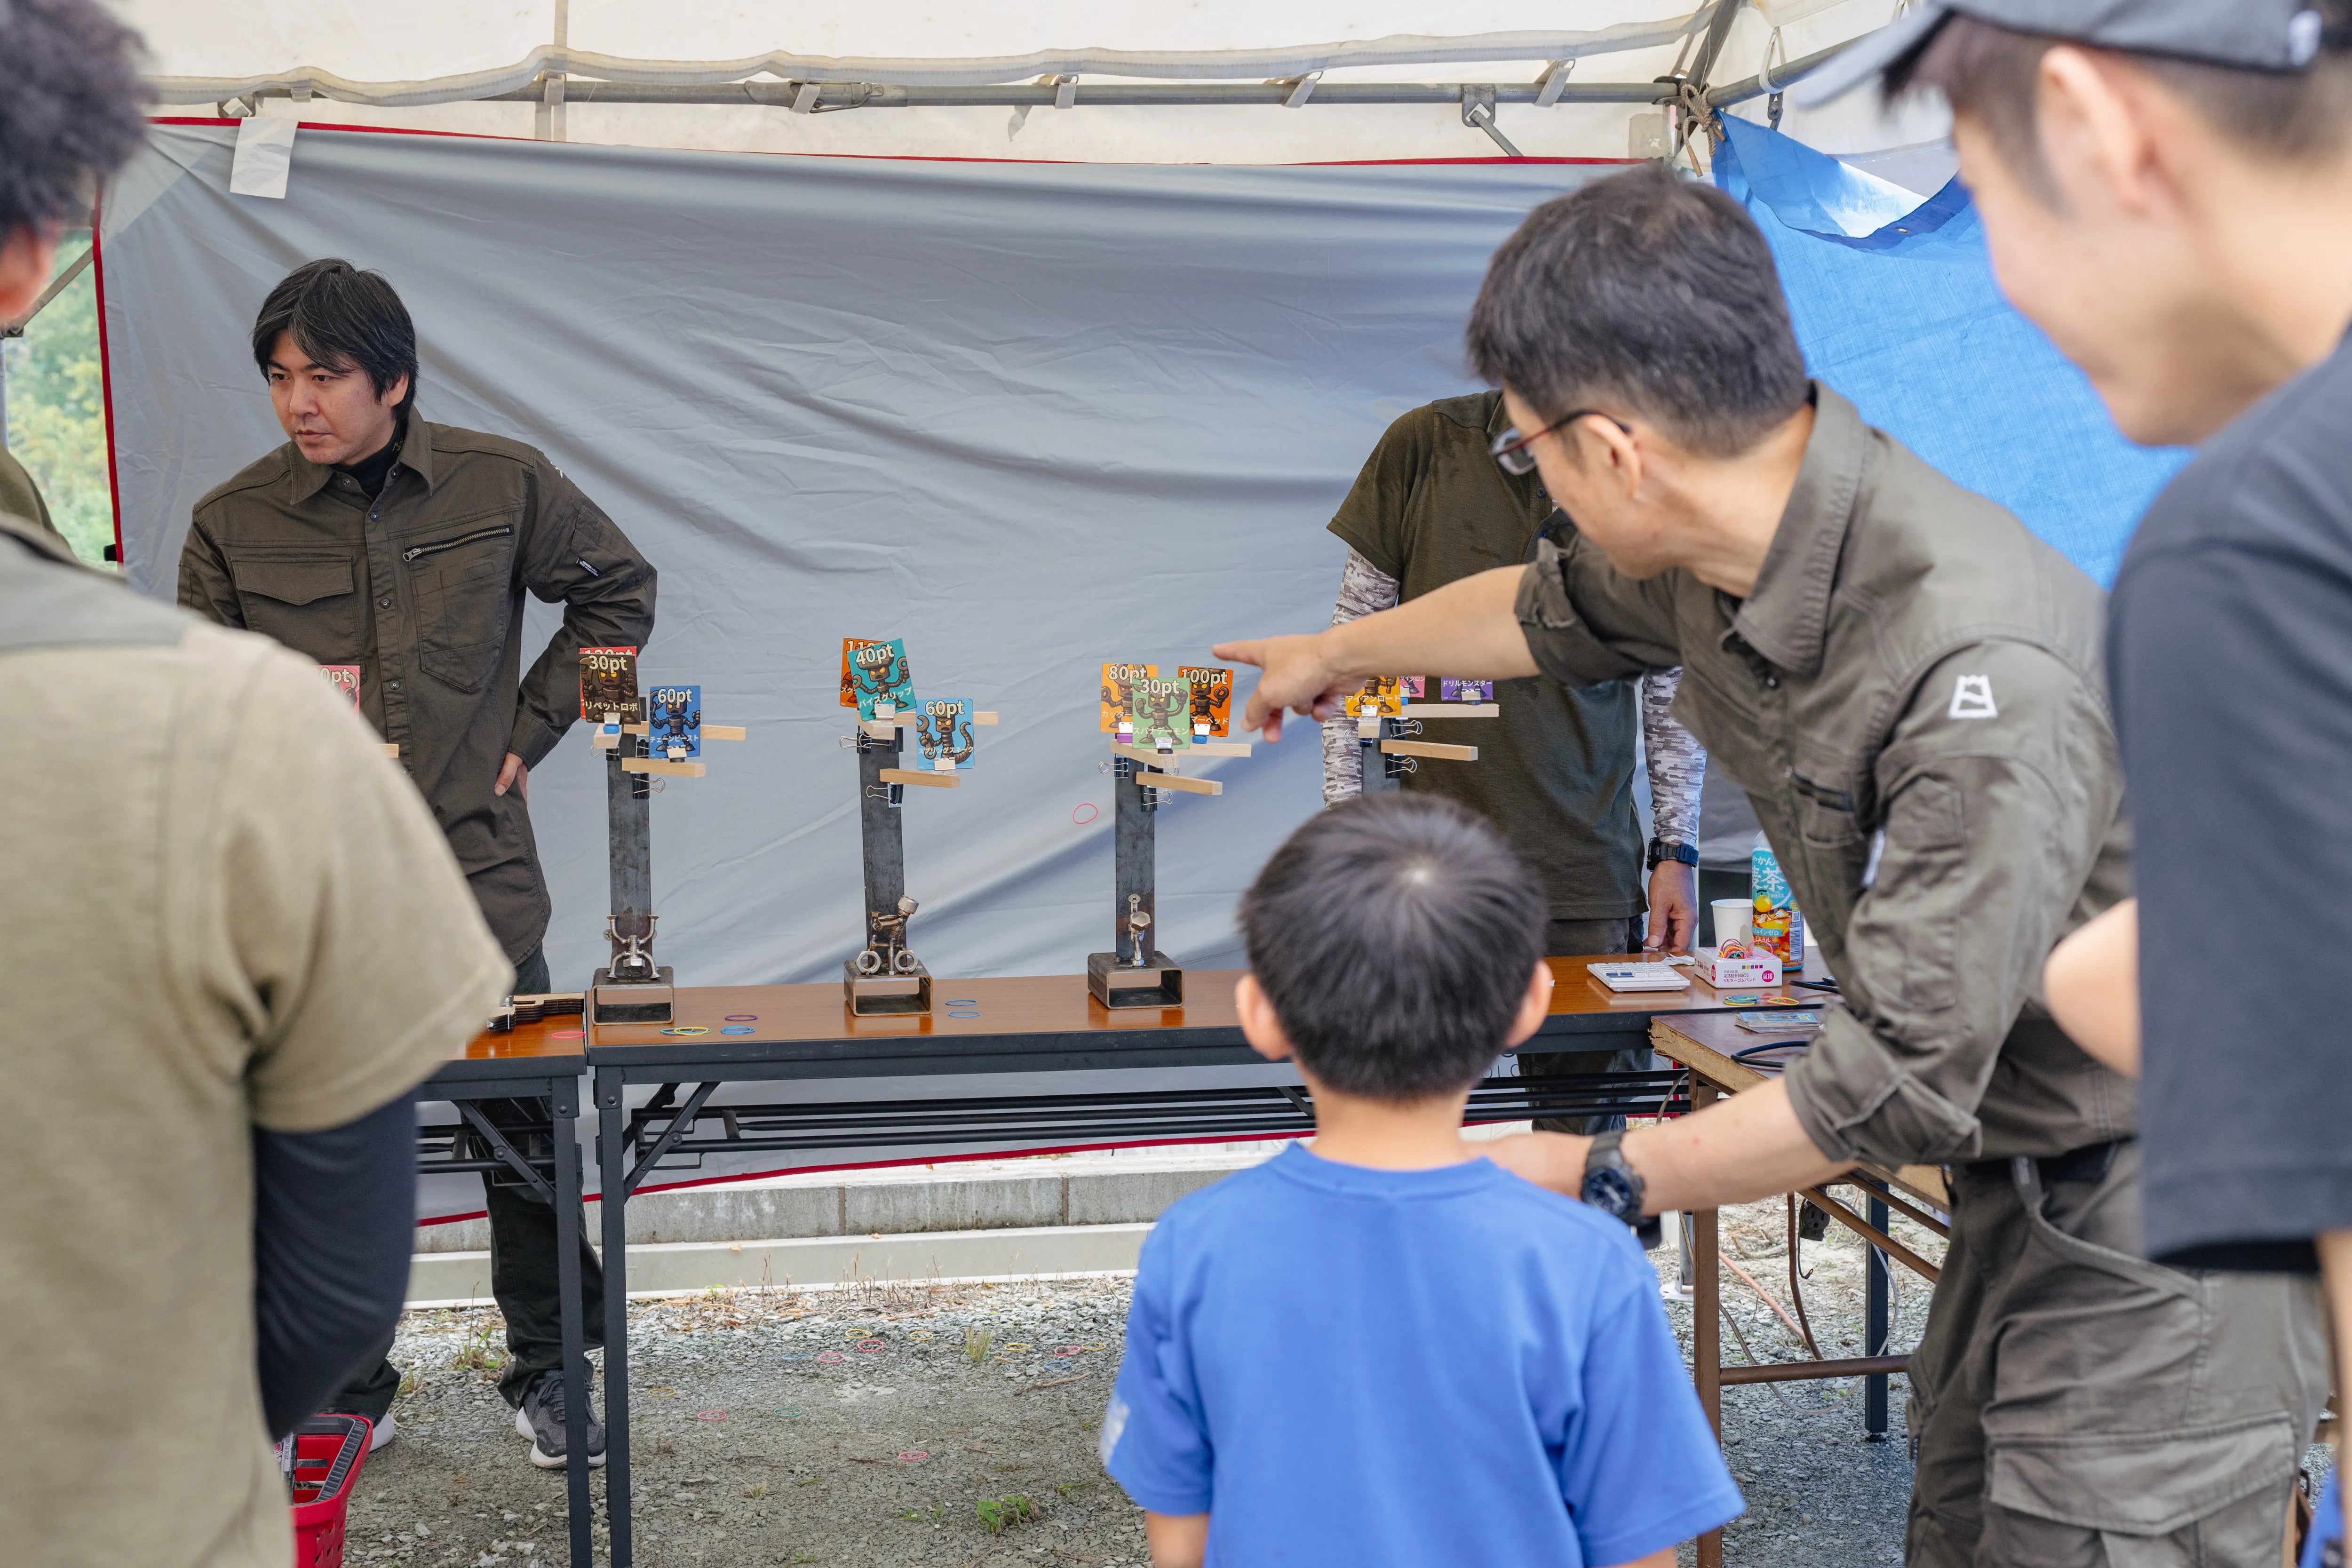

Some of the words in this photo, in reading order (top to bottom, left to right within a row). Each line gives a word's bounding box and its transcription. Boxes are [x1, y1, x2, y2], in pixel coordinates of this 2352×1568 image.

[856, 644, 895, 665] 40pt
[588, 655, 628, 674] 30pt
[318, 668, 350, 686] 0pt
[1108, 666, 1147, 684] 80pt
[1181, 669, 1228, 687] 100pt
[658, 688, 693, 706] 60pt
[859, 686, 912, 708] バイスグリップ
[1140, 679, 1180, 697] 30pt
[585, 701, 638, 712] リベットロボ
[1346, 694, 1400, 703] アイアンロード
[925, 700, 965, 719] 60pt
[1133, 727, 1189, 735] スパナデーモン
[1753, 855, 1779, 866] やかん
